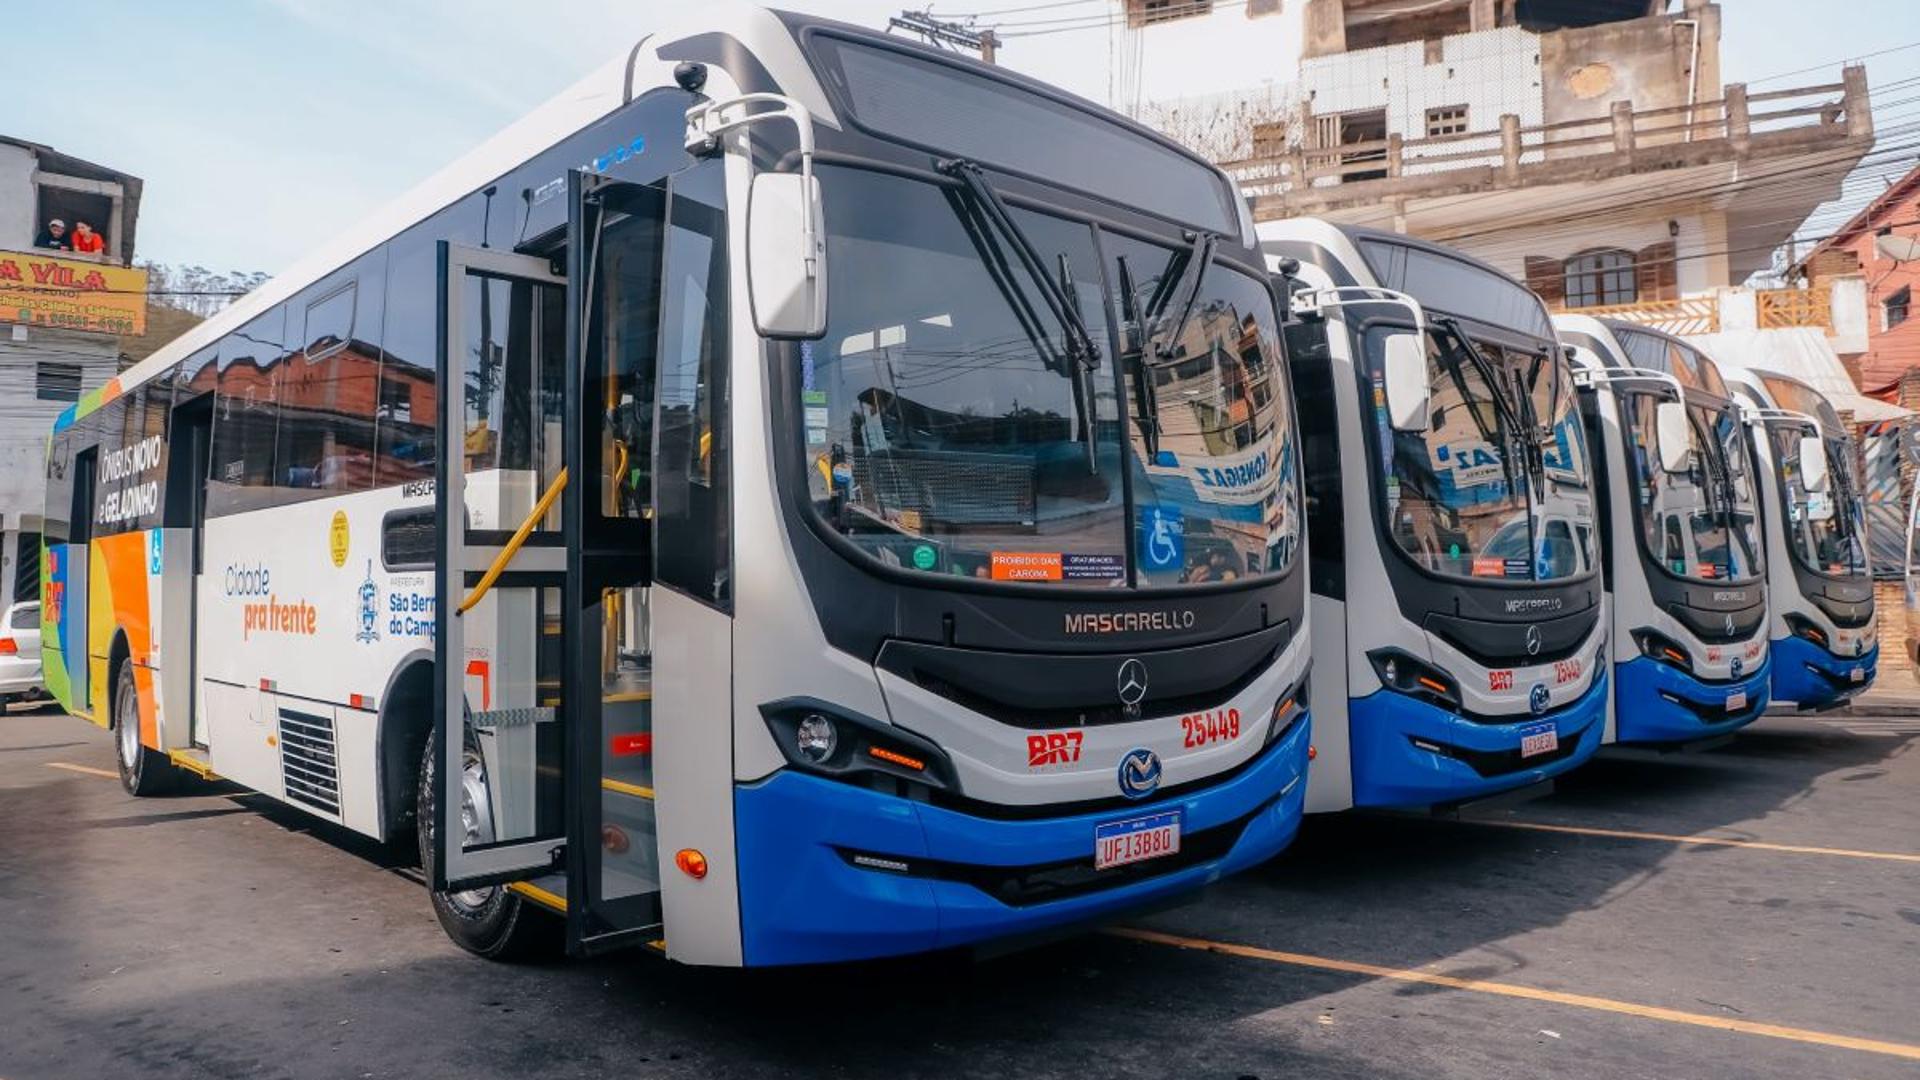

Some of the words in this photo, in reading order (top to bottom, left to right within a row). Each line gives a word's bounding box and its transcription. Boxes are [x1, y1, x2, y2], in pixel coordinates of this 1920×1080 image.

[29, 261, 107, 291] VILA
[132, 435, 160, 475] NOVO
[105, 481, 158, 523] GELADINHO
[225, 562, 270, 596] Cidade
[269, 593, 317, 635] frente
[389, 592, 409, 612] São
[389, 615, 404, 635] do
[1065, 610, 1195, 633] MASCARELLO
[1181, 708, 1240, 748] 25449
[1026, 730, 1084, 768] BR7
